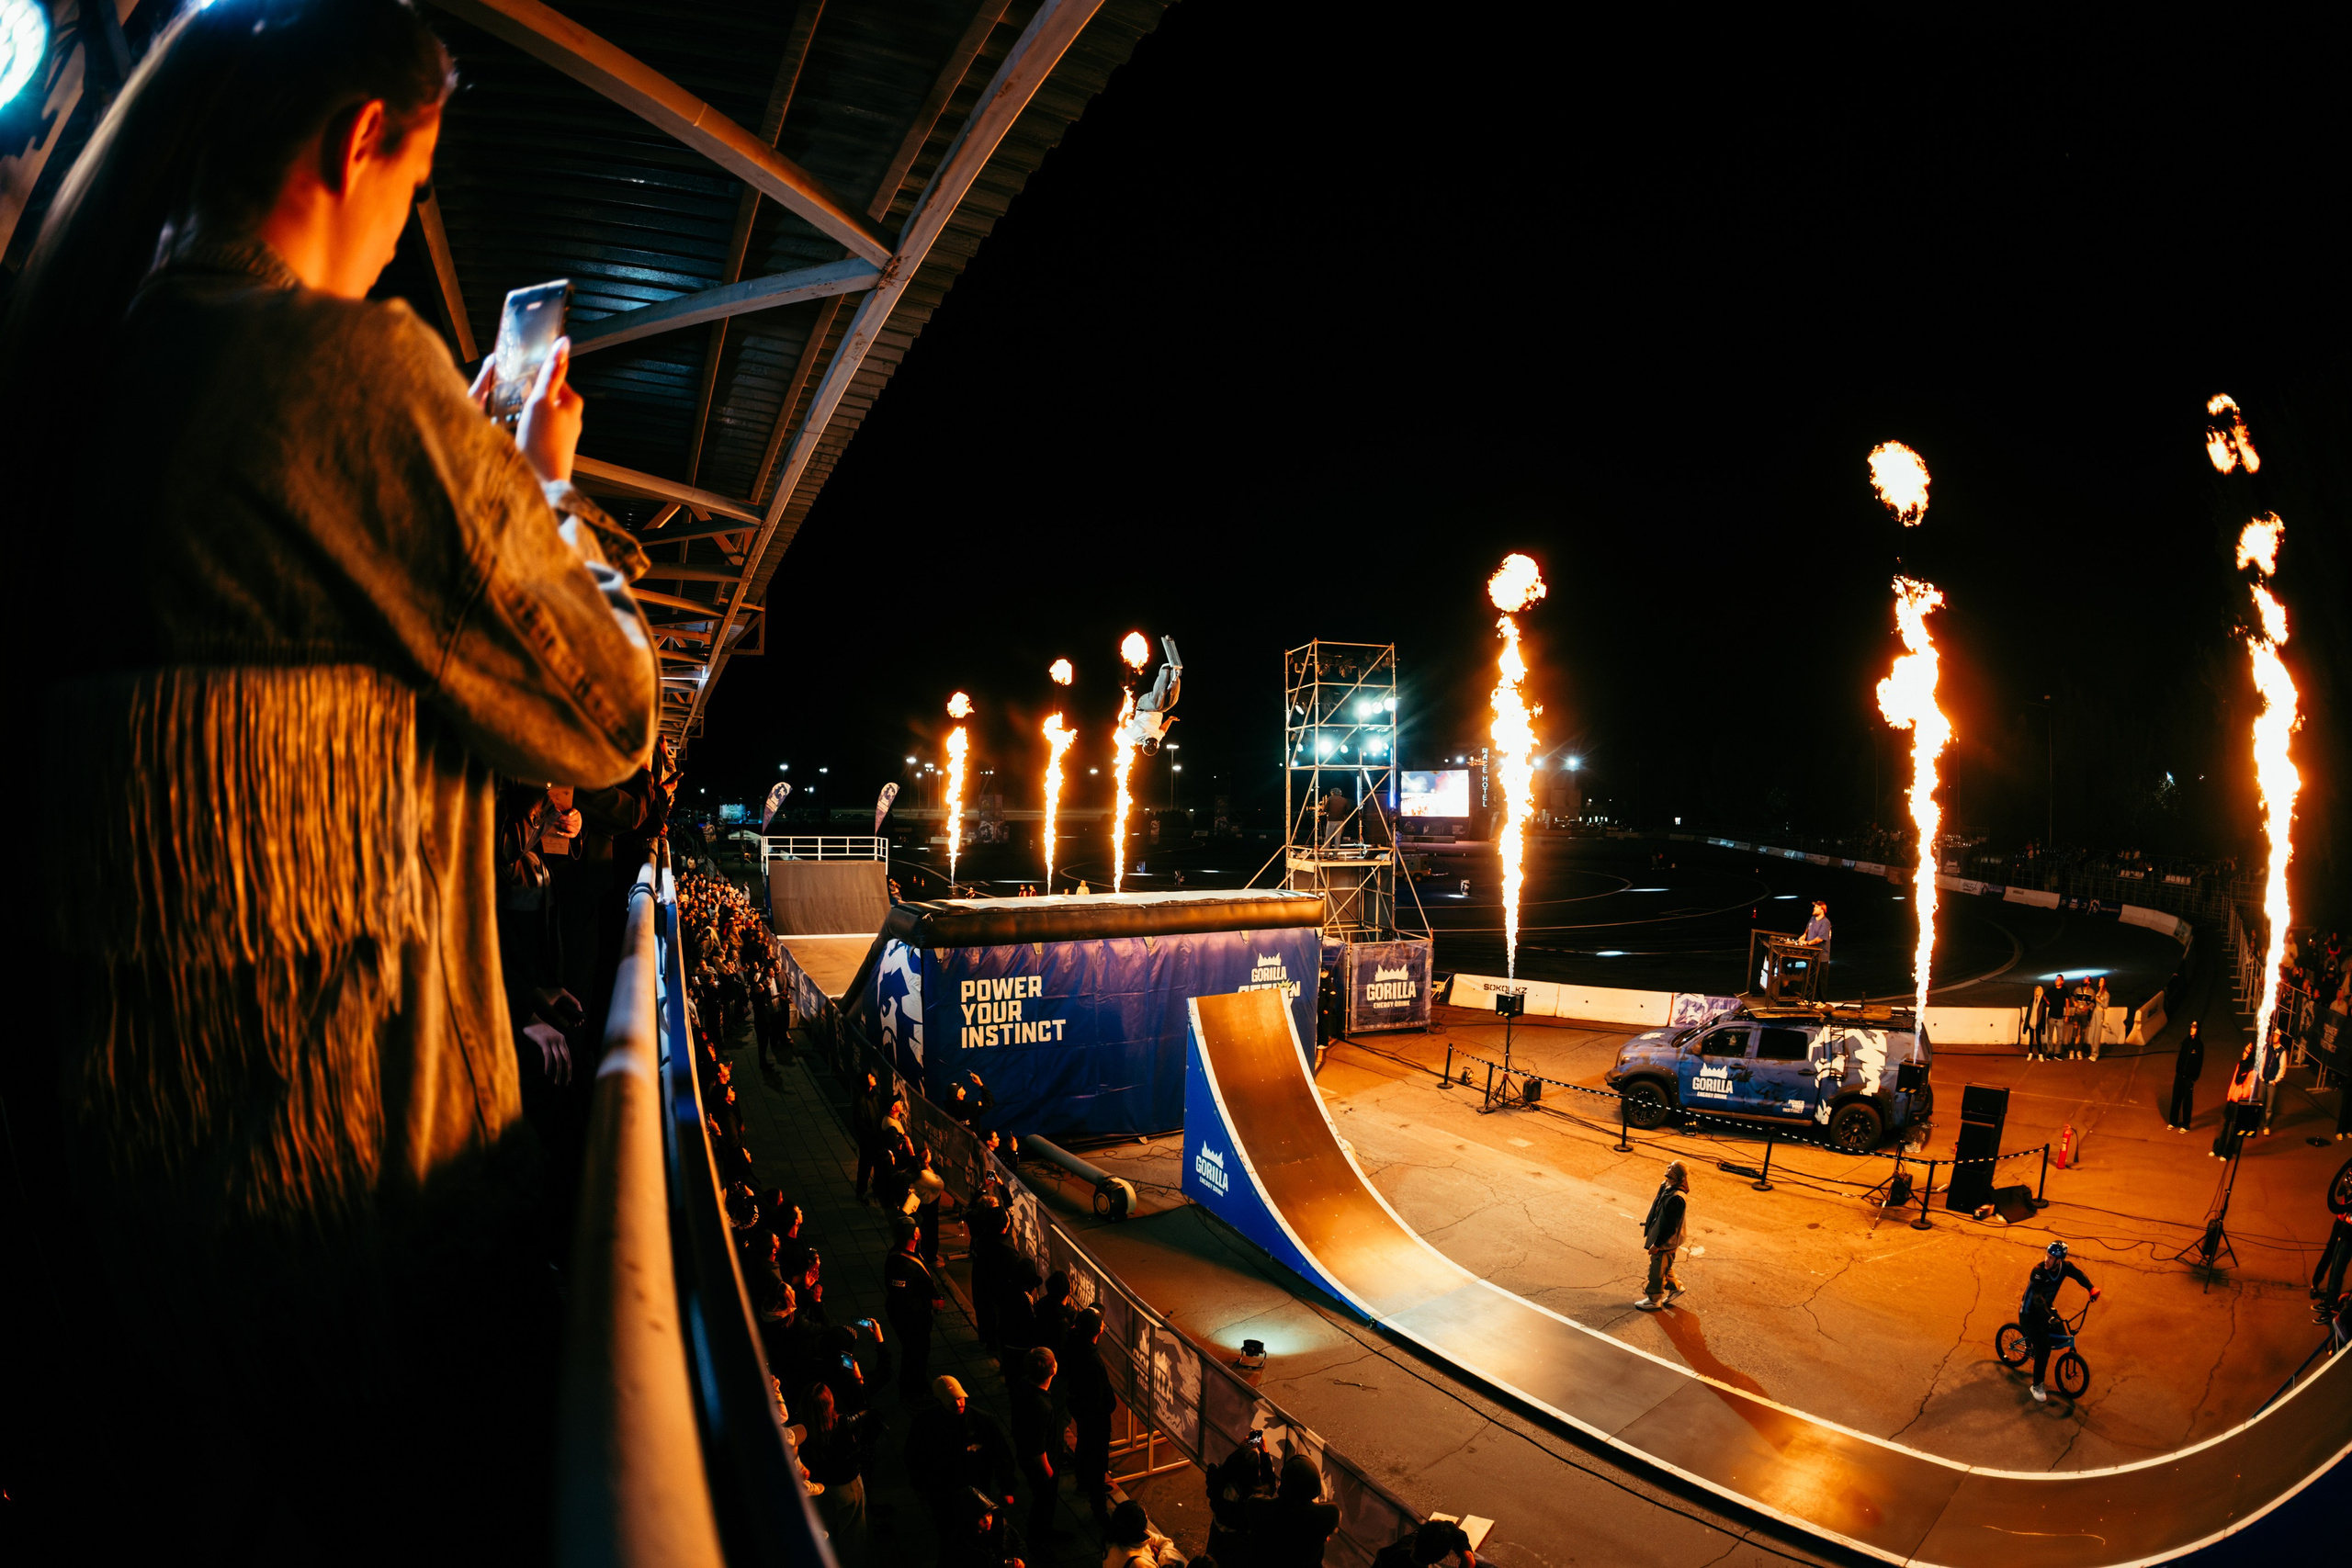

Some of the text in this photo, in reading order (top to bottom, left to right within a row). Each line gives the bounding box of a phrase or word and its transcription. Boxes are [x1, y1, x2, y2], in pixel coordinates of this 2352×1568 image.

[1251, 966, 1287, 982] GORILLA
[961, 976, 1042, 1003] POWER
[1366, 981, 1416, 1001] GORILLA
[961, 1000, 1022, 1025] YOUR
[961, 1019, 1067, 1048] INSTINCT
[1692, 1077, 1734, 1094] GORILLA
[1195, 1155, 1228, 1192] GORILLA
